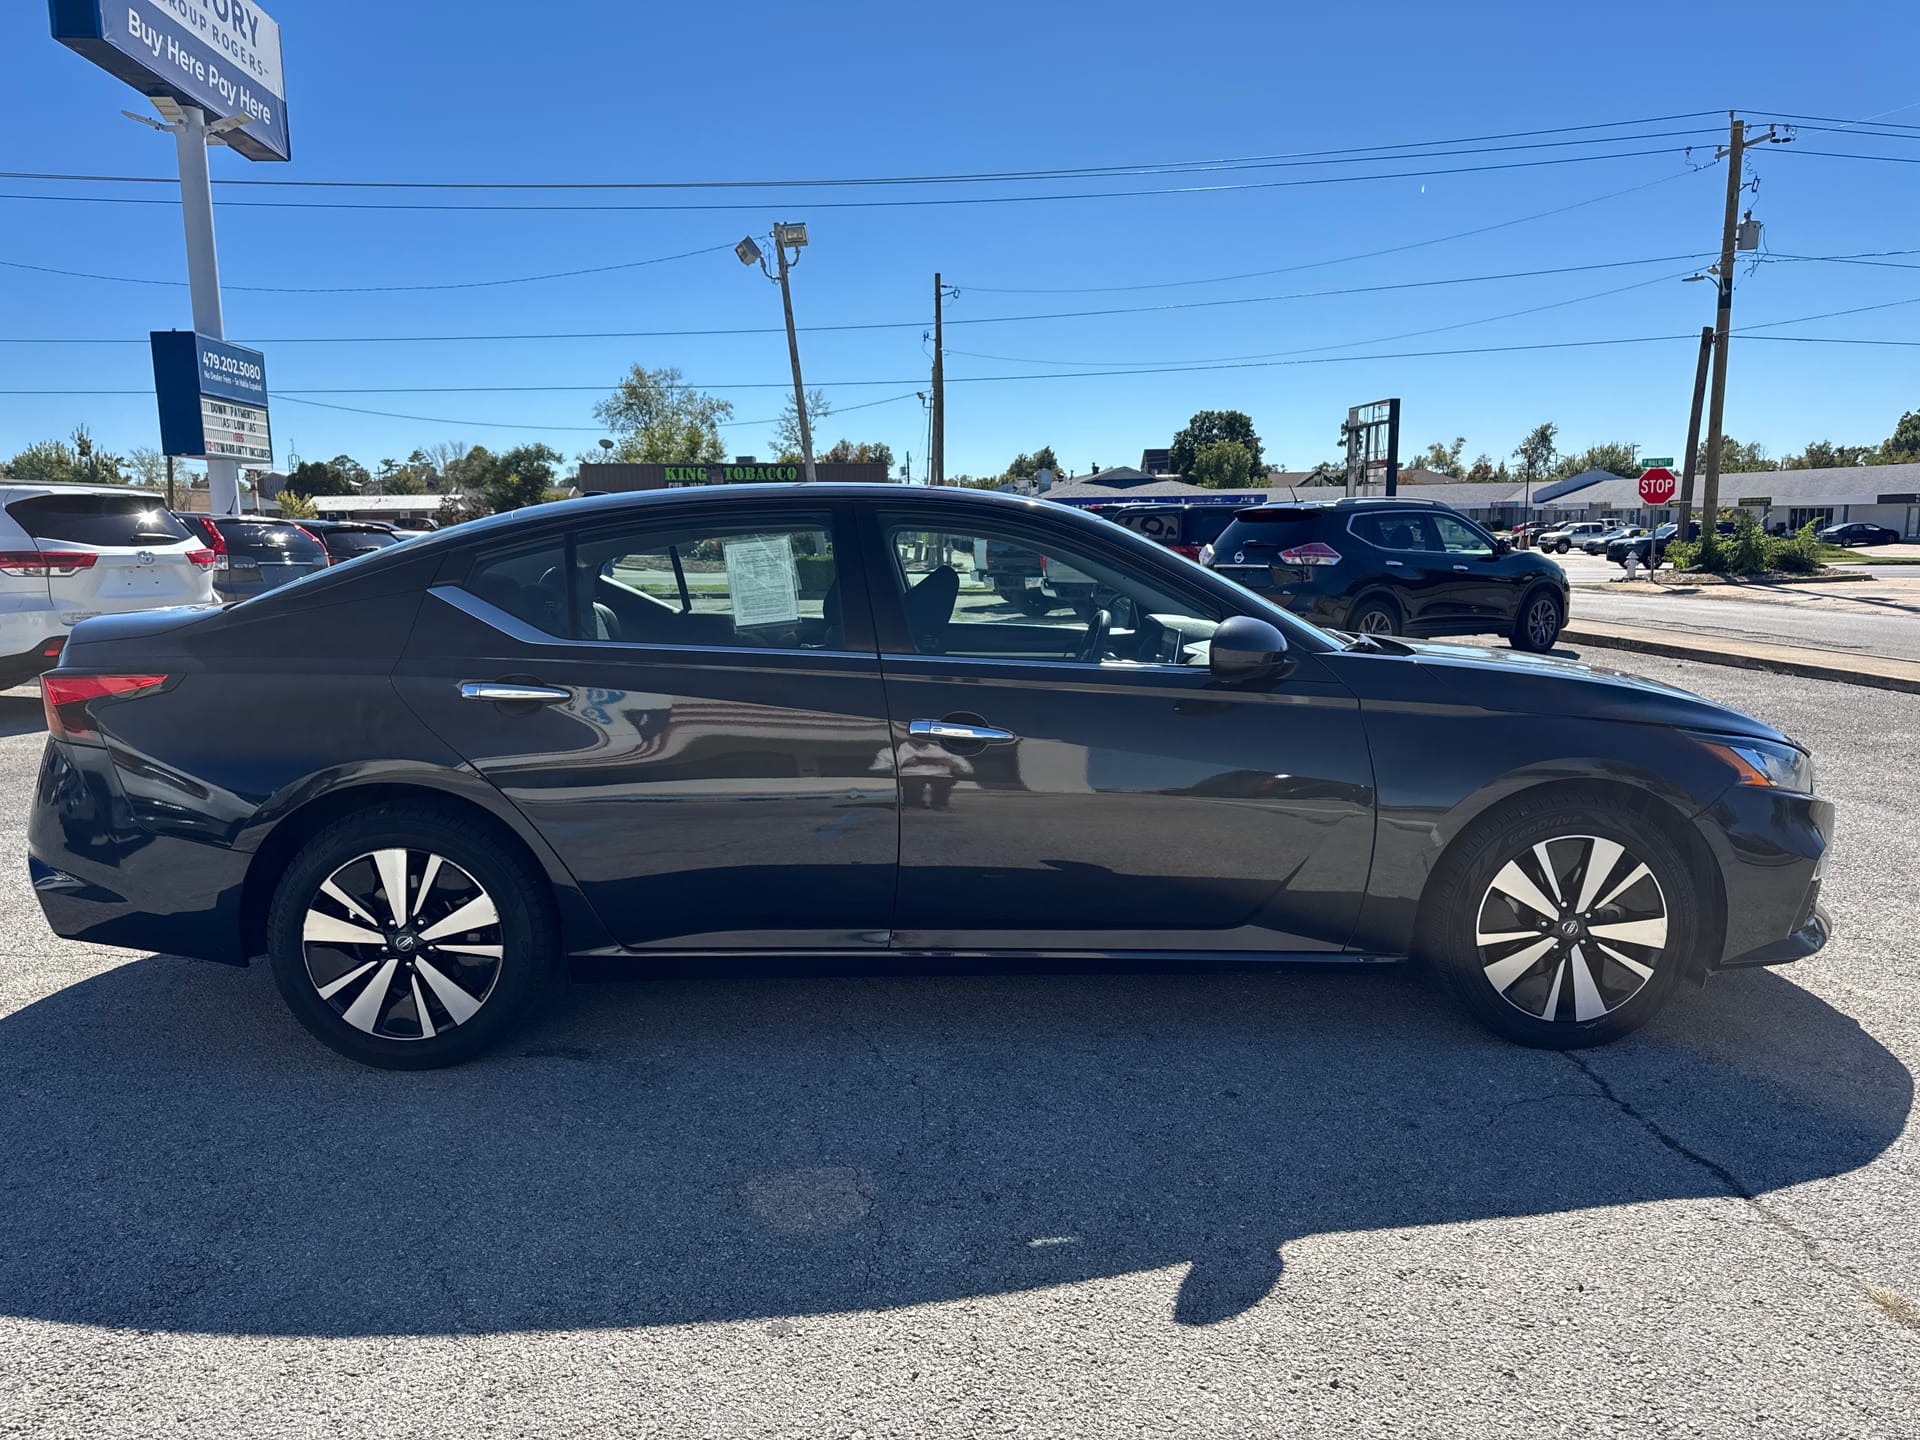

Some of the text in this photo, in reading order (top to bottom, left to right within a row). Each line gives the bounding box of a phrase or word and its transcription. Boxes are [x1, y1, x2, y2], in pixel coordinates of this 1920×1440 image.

[203, 0, 258, 48] ORY
[163, 0, 263, 76] ROUP ROGERS
[128, 8, 271, 125] Buy Here Pay Here
[203, 352, 261, 380] 479.202.5080
[210, 403, 257, 421] DOWN PAYMENTS
[223, 418, 256, 432] AS LOW AS
[664, 467, 798, 480] KING TOBACCO
[1641, 479, 1674, 493] STOP
